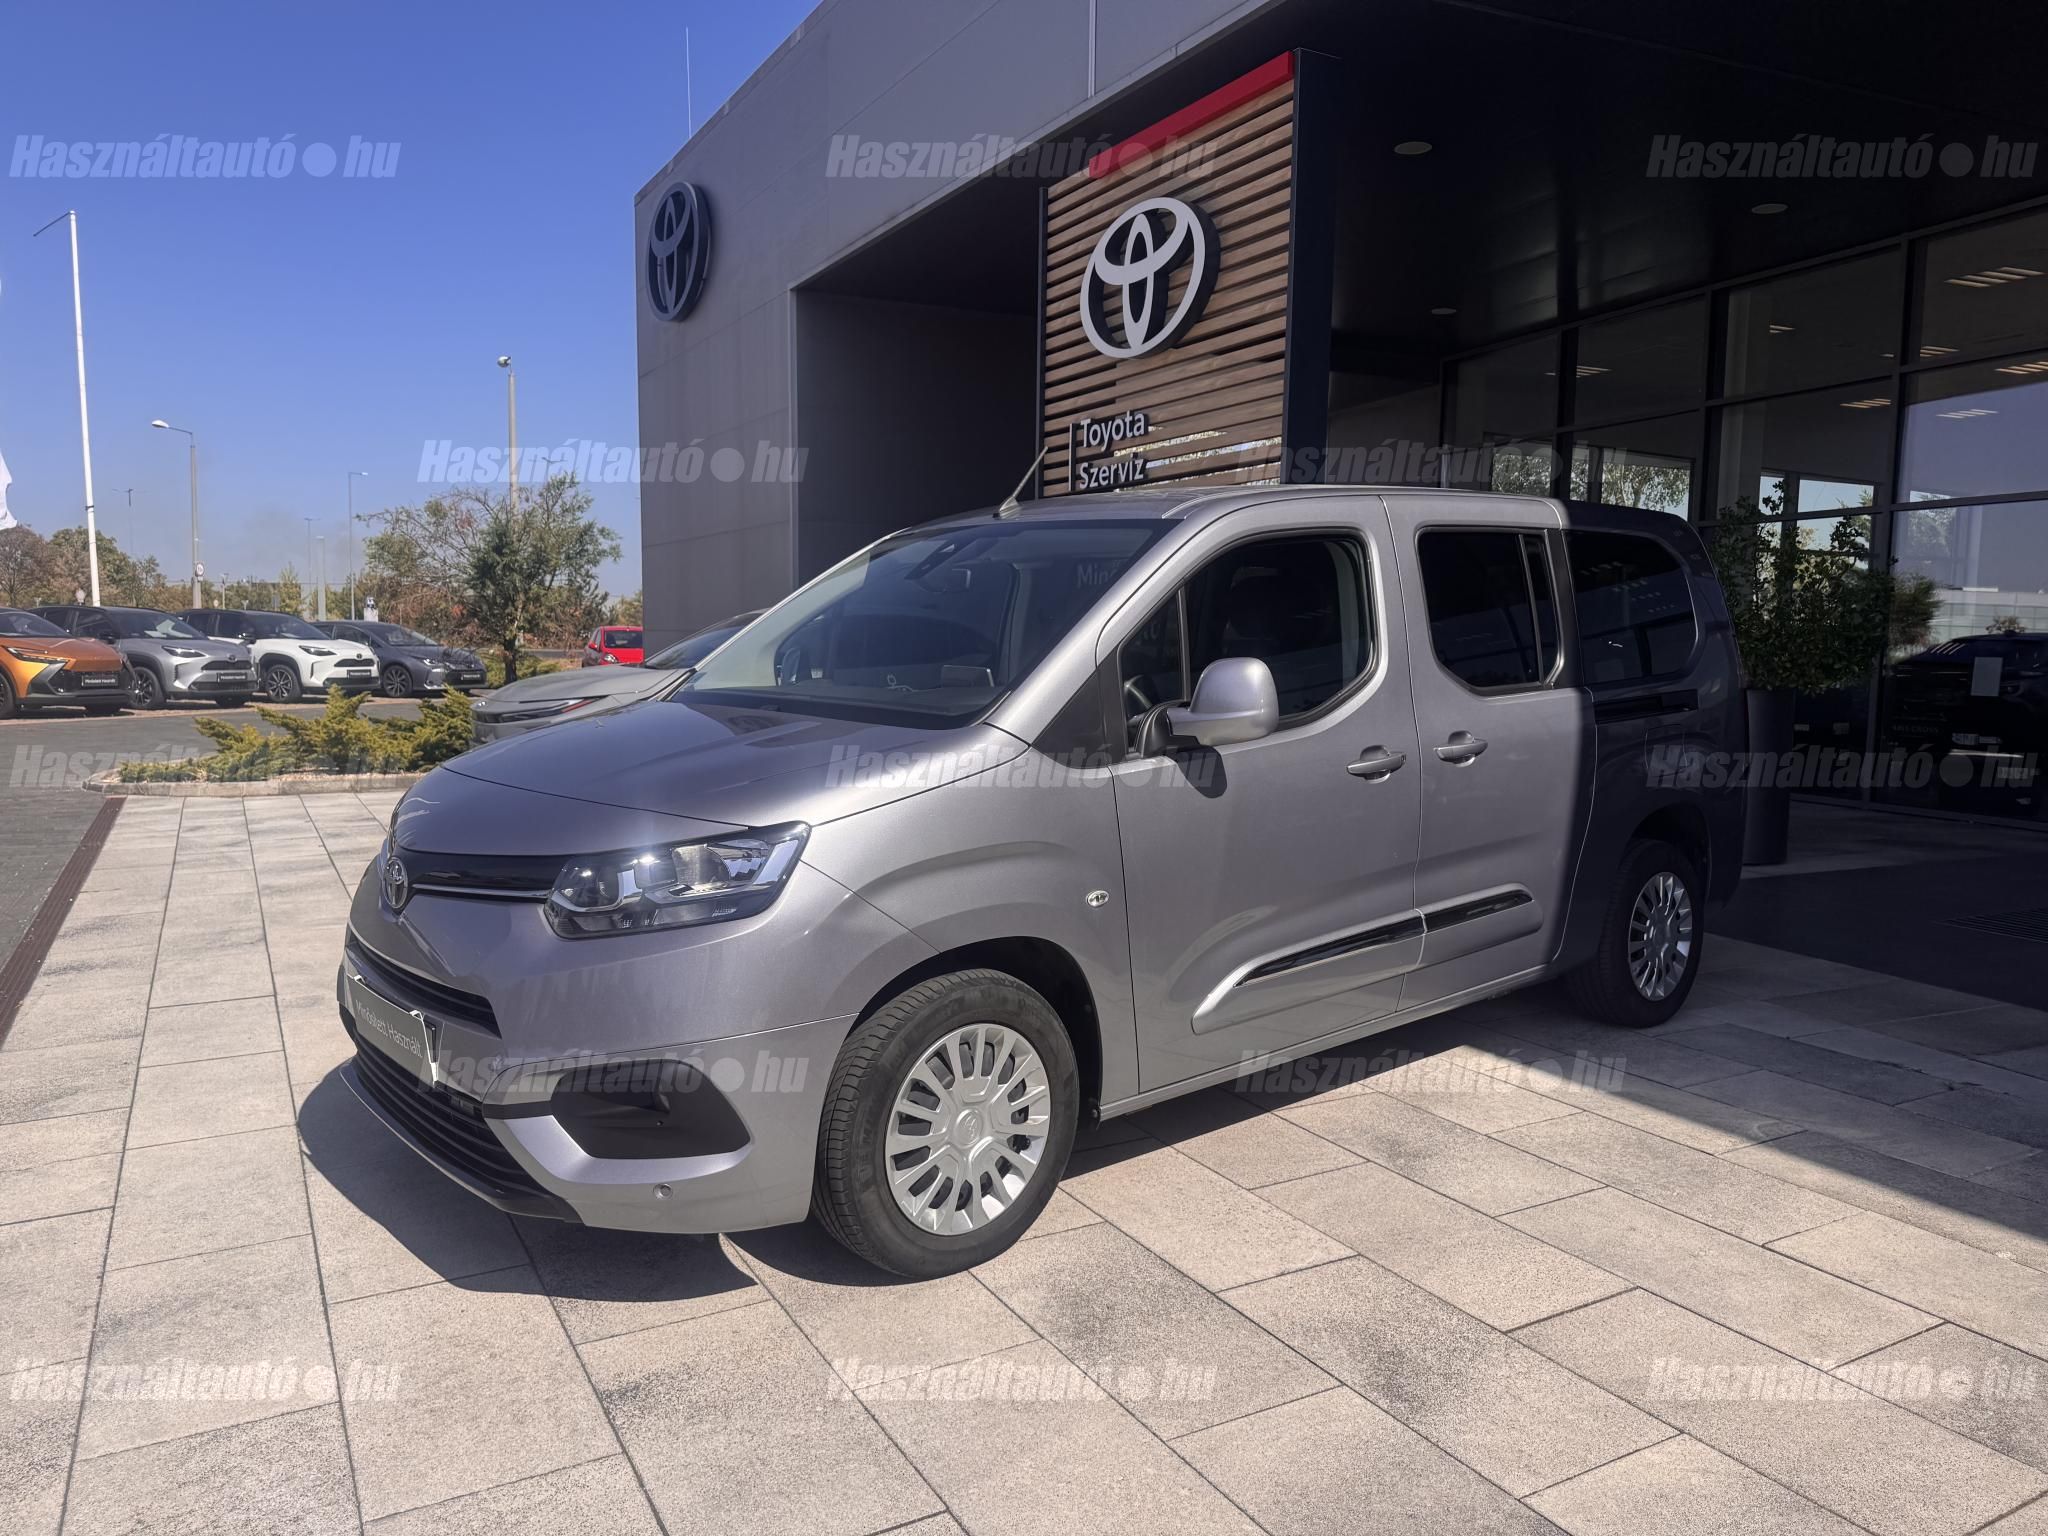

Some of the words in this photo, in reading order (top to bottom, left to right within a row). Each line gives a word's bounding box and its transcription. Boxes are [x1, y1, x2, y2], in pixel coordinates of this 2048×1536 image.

[1080, 410, 1145, 452] Toyota
[1080, 452, 1144, 489] Szerviz
[387, 1023, 423, 1058] Használt
